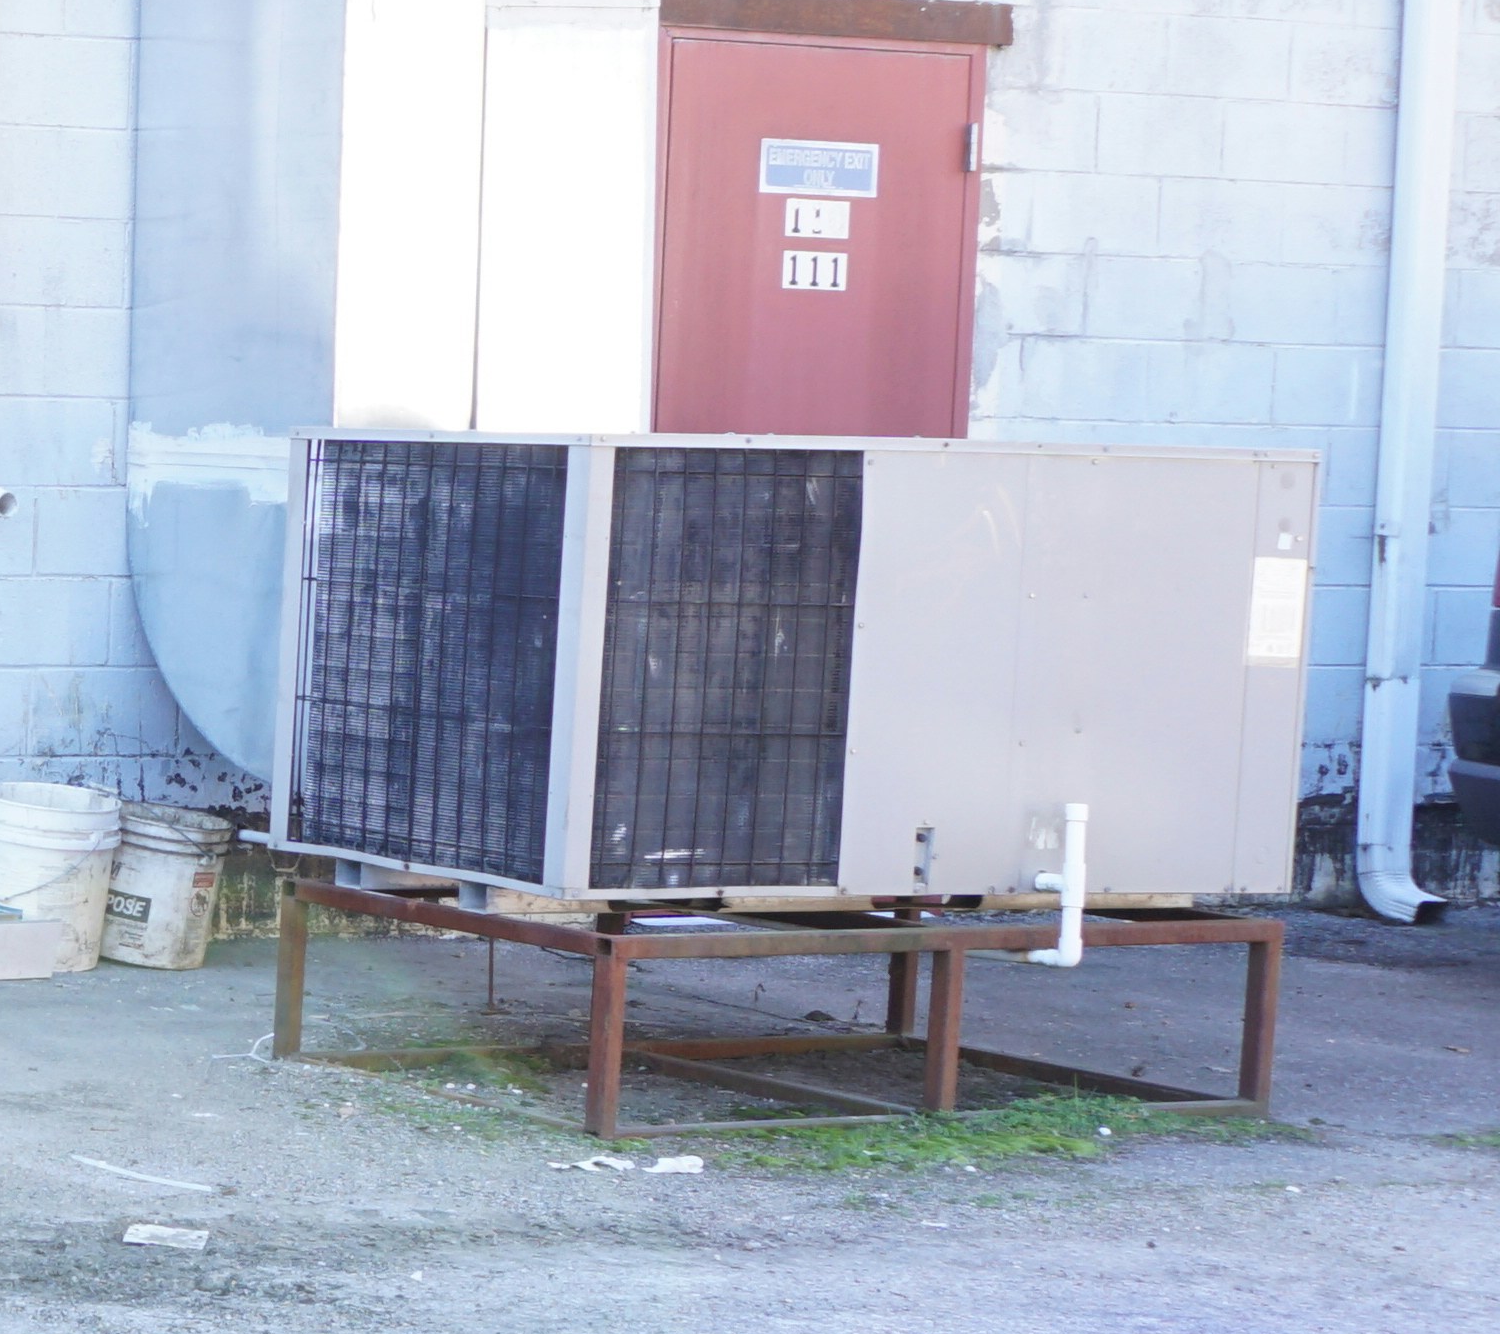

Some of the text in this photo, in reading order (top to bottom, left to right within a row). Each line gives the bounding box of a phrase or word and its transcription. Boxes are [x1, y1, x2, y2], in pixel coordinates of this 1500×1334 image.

[768, 147, 872, 170] EMERGENCY EXIT
[802, 169, 836, 187] ONLY
[788, 254, 840, 288] 111
